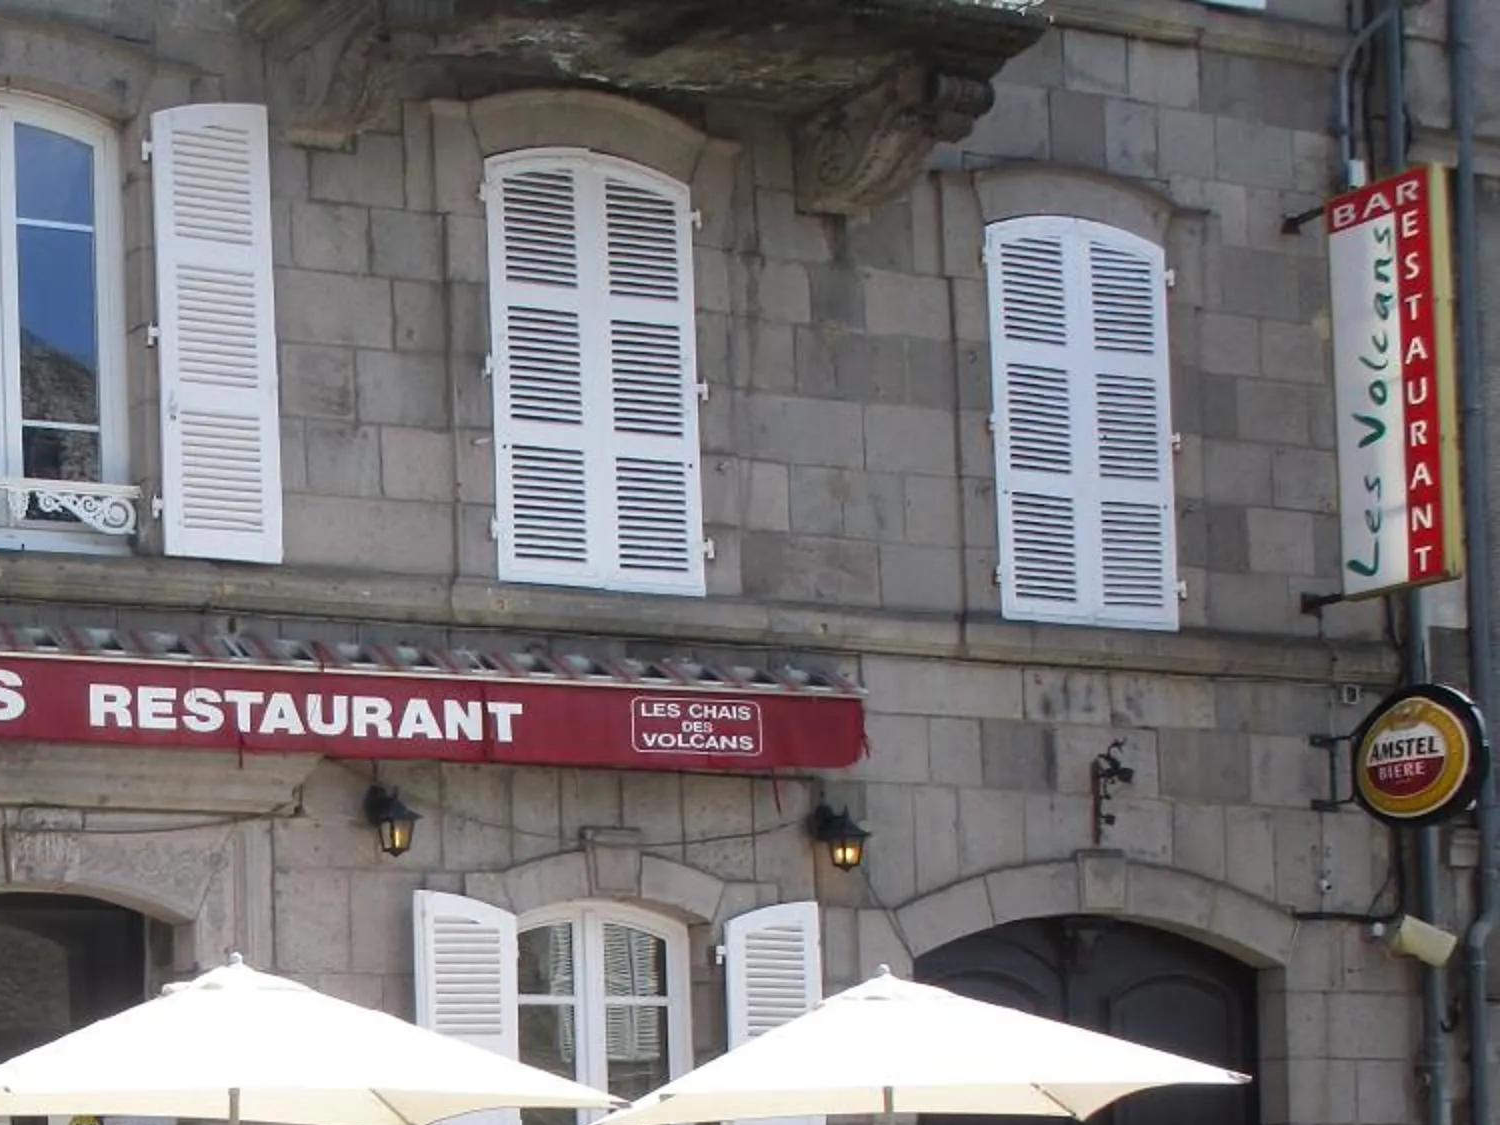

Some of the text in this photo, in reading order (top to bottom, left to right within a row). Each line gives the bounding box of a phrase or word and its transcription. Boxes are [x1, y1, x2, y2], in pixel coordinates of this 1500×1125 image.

[1333, 179, 1421, 229] BAR
[1346, 224, 1394, 578] Les Volcans
[88, 683, 524, 744] RESTAURANT
[641, 703, 751, 720] LES CHAIS
[682, 720, 714, 732] DES
[643, 733, 754, 750] VOLCANS
[1371, 736, 1439, 761] AMSTEL
